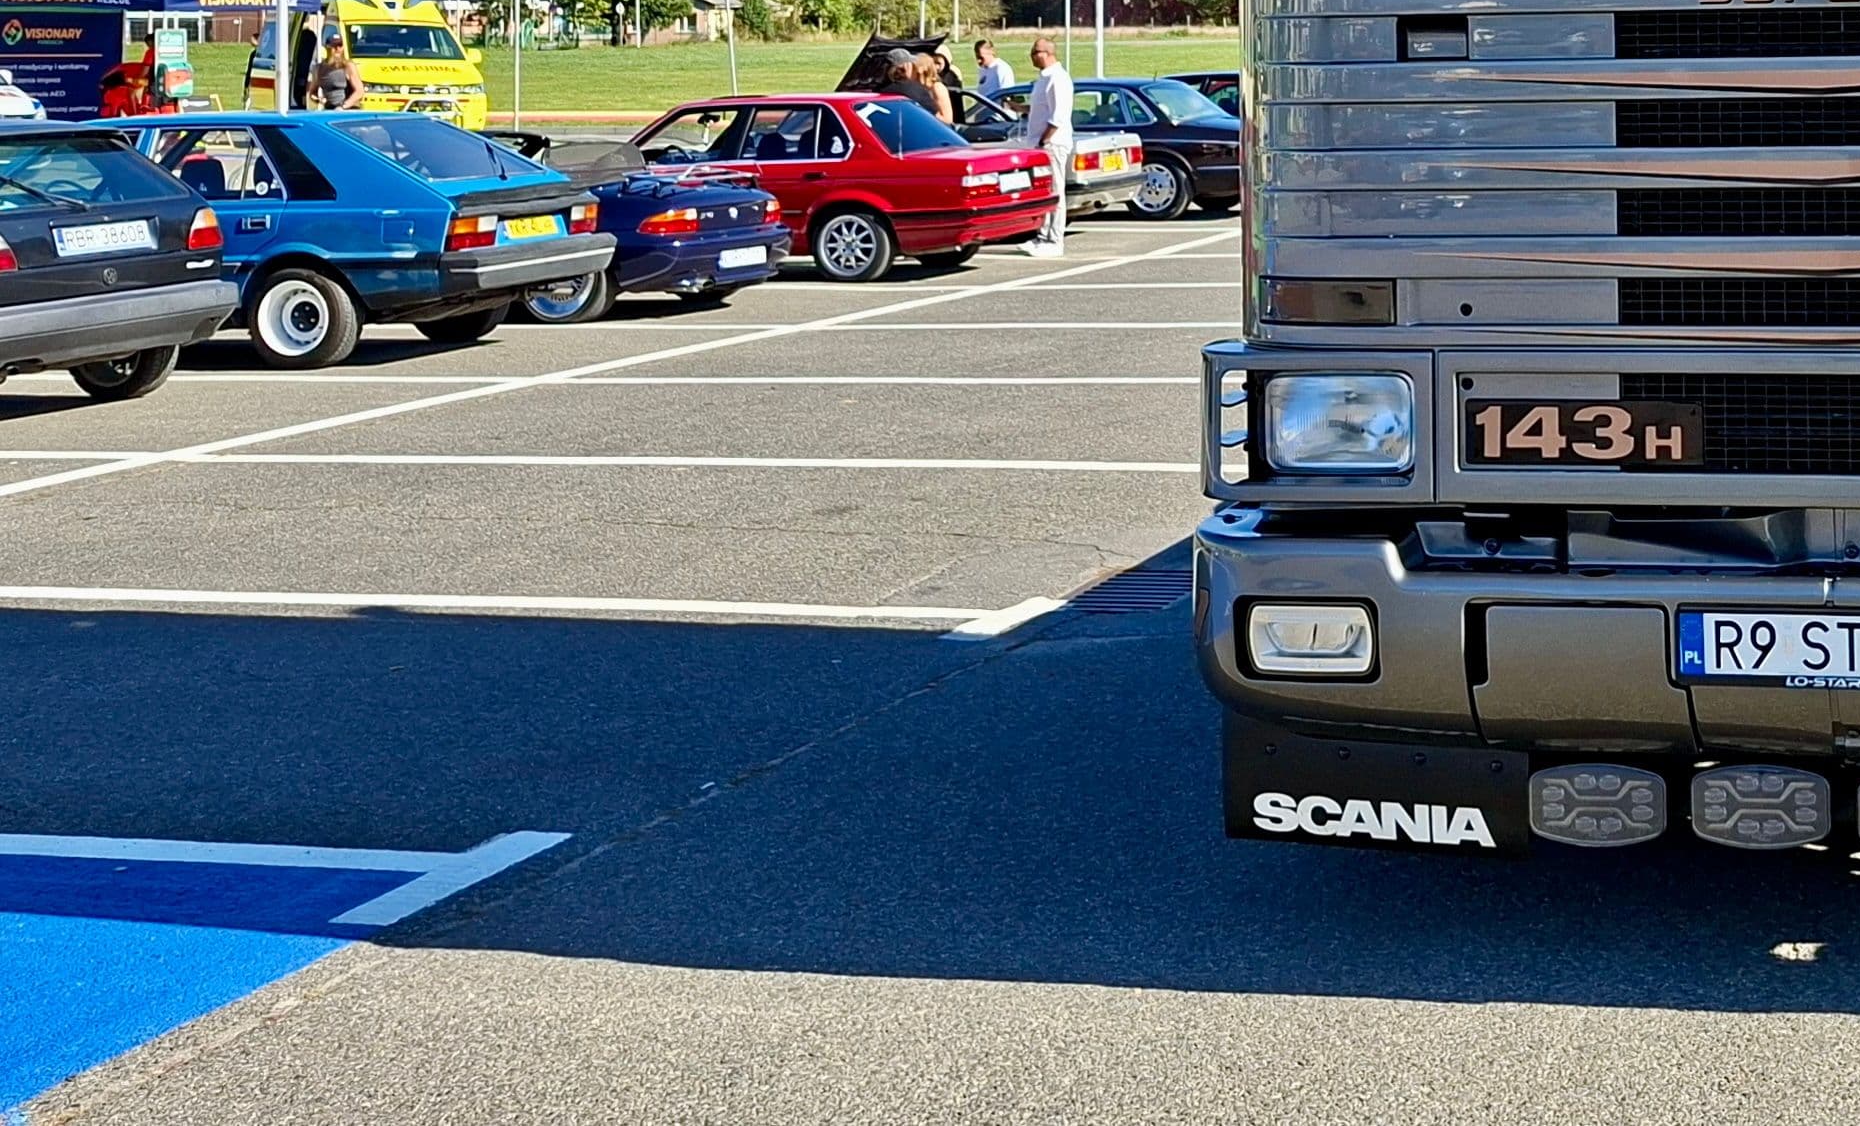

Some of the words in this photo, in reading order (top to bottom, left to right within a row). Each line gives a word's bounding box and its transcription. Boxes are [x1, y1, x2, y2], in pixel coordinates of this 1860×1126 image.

[25, 28, 83, 39] VISIONARY
[1684, 651, 1703, 665] PL
[1714, 619, 1777, 669] R9
[1253, 791, 1497, 848] SCANIA
